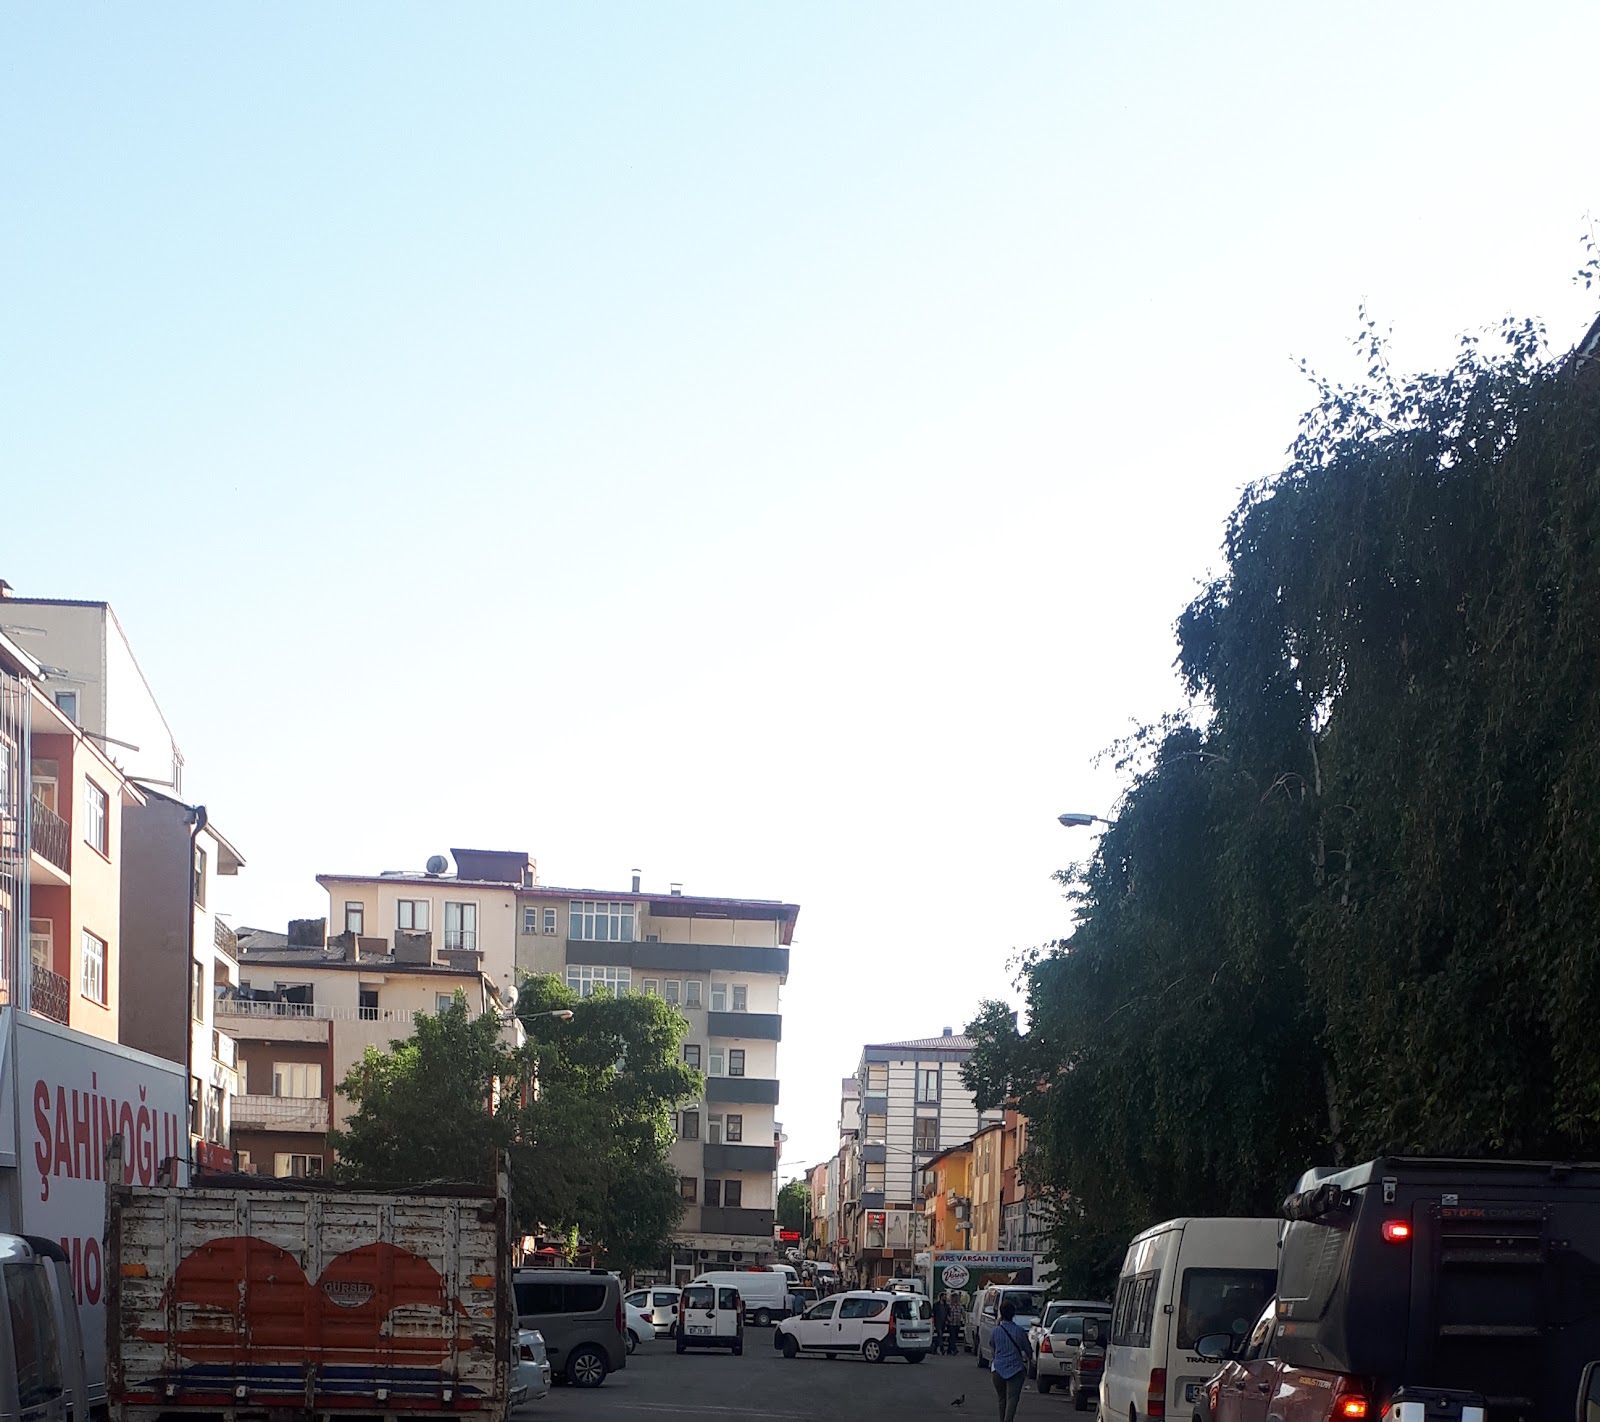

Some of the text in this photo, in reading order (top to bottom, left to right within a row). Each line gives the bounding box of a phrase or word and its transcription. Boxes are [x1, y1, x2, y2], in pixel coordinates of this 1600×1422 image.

[1441, 1207, 1485, 1217] STORK
[60, 1237, 102, 1306] MO
[323, 1281, 373, 1294] GÜRSEL
[1185, 1356, 1223, 1364] TRANSIT
